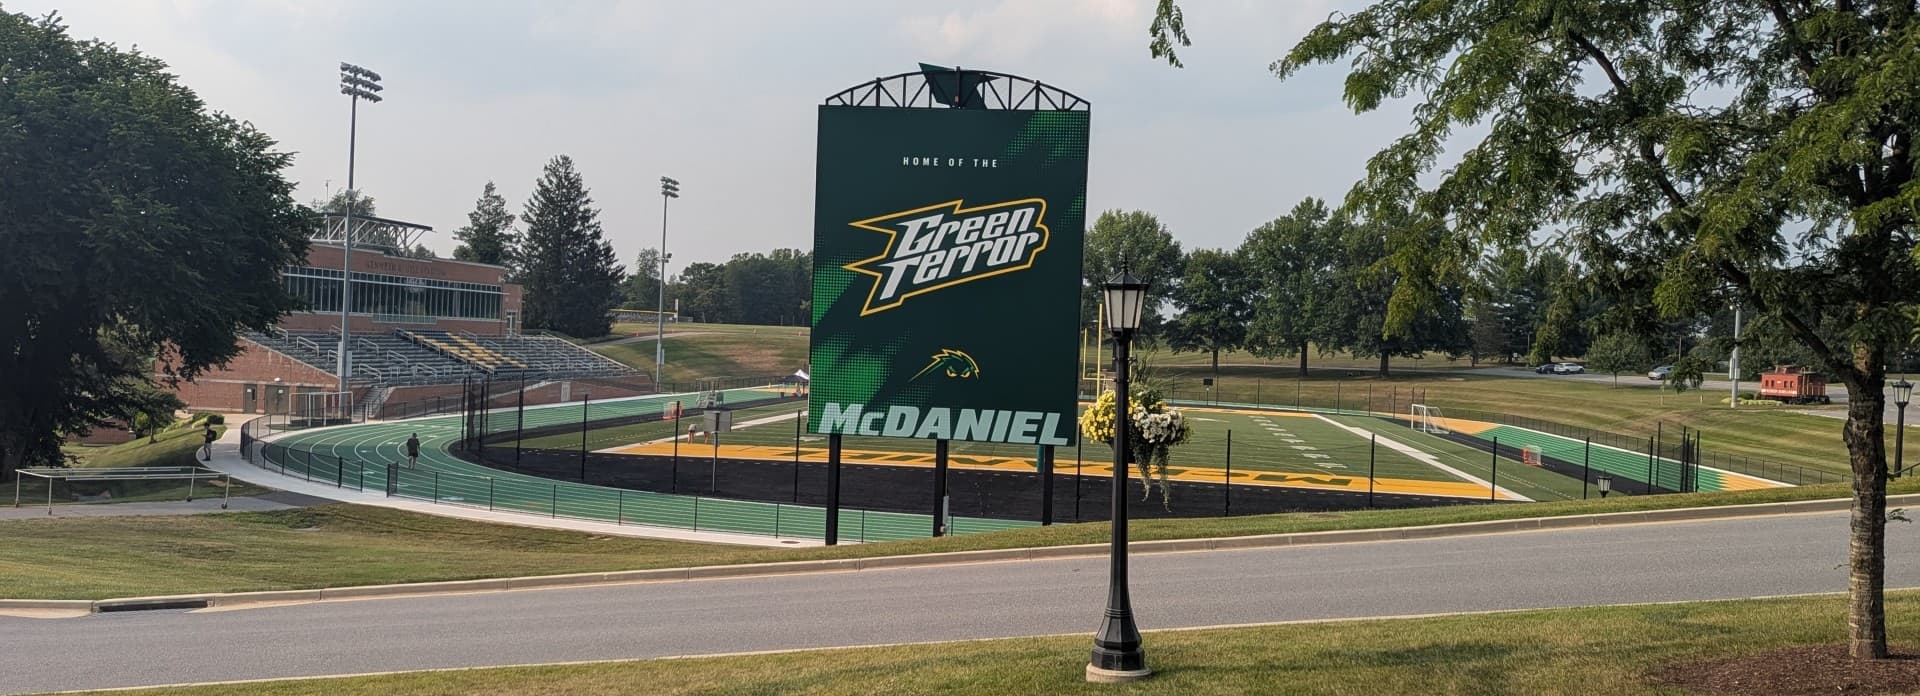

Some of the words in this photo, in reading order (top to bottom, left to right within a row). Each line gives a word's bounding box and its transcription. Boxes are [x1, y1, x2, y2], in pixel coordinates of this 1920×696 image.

[903, 156, 938, 166] HOME
[948, 158, 963, 167] OF
[973, 158, 997, 168] THE
[893, 207, 1036, 259] Green
[877, 232, 1040, 301] Terror
[818, 402, 1069, 446] McDANIEL
